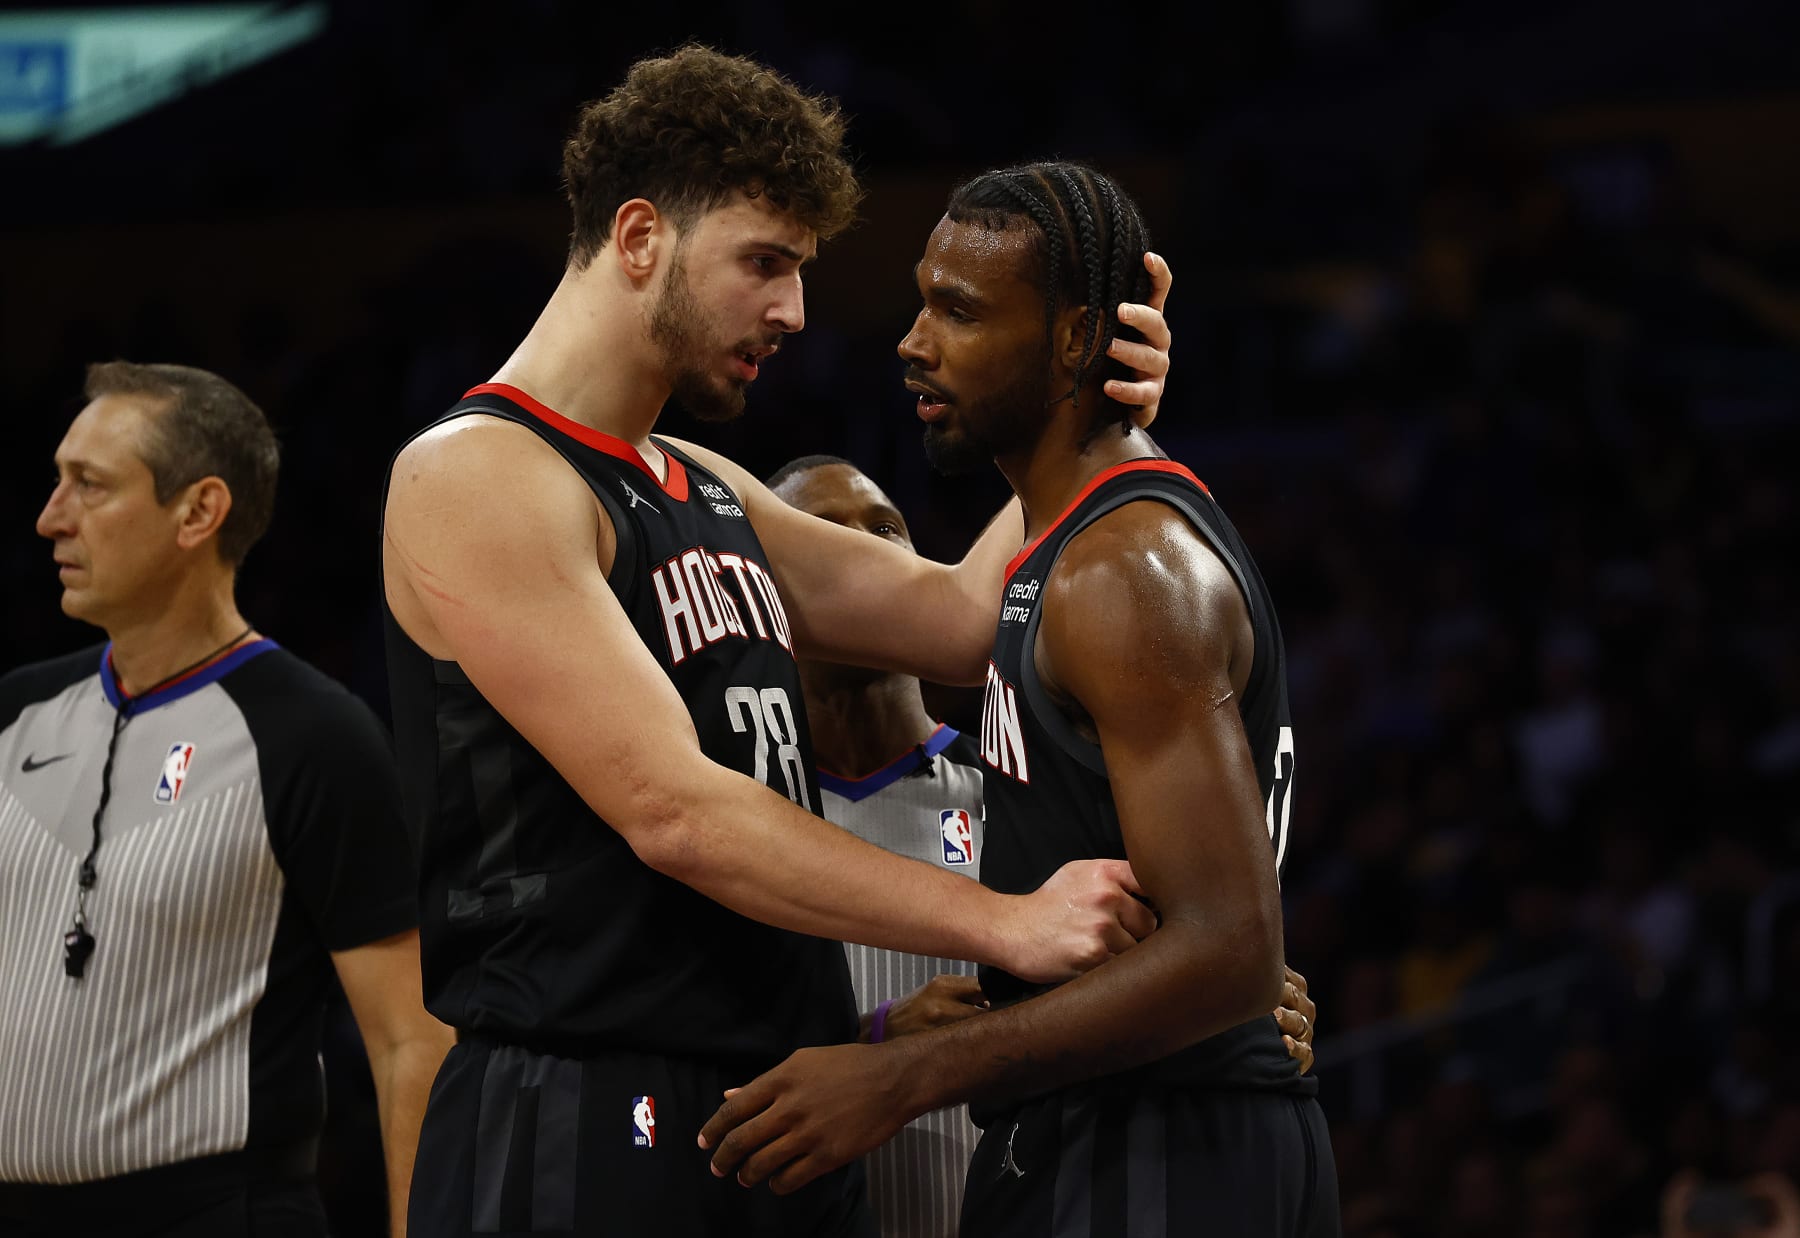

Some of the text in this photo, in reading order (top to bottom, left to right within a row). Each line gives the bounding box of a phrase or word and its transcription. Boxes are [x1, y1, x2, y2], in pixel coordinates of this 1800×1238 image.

[1009, 579, 1039, 600] credit
[1002, 600, 1030, 623] karma
[947, 850, 962, 862] NBA
[634, 1135, 647, 1146] NBA
